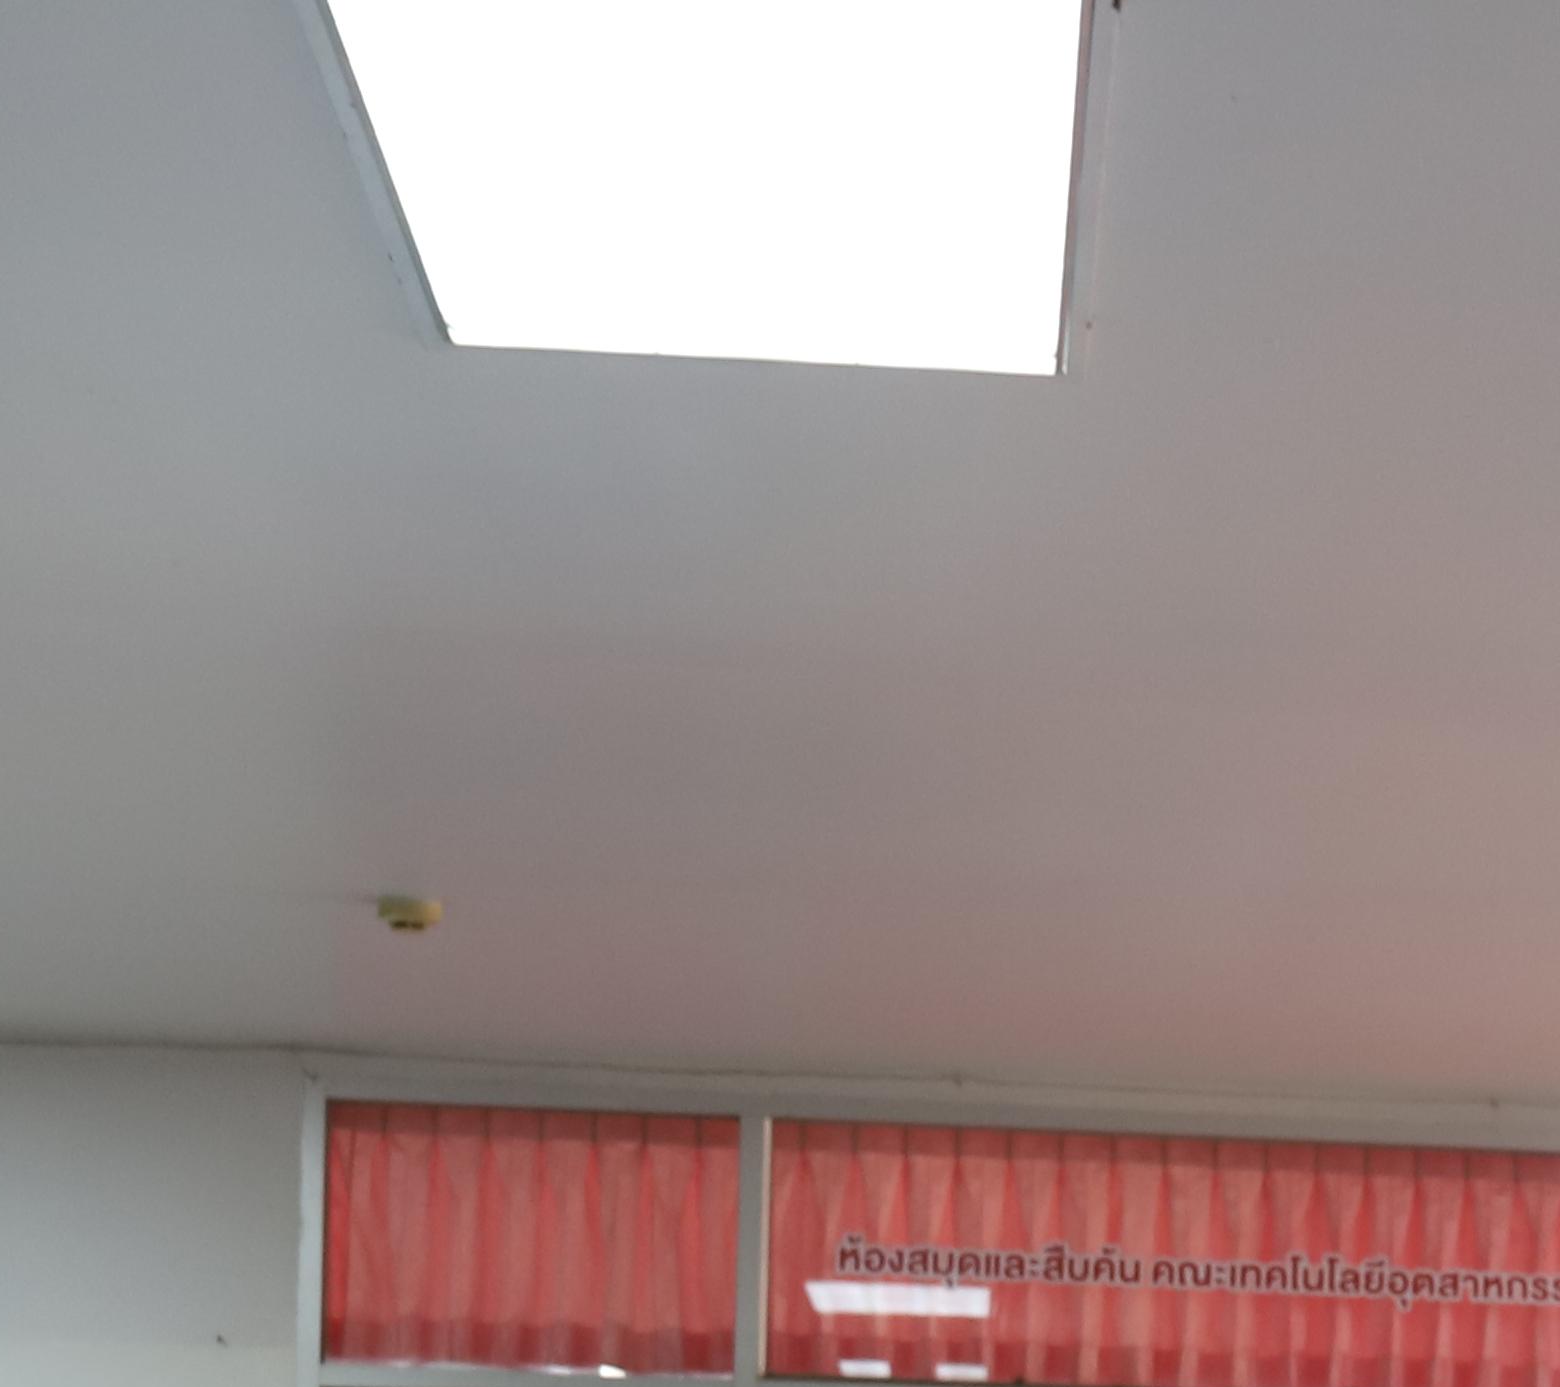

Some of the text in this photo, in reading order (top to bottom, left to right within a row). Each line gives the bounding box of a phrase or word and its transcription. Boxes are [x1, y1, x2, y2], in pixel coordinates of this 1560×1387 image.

[837, 1234, 1143, 1288] ห้องสมุดและสืบค้น
